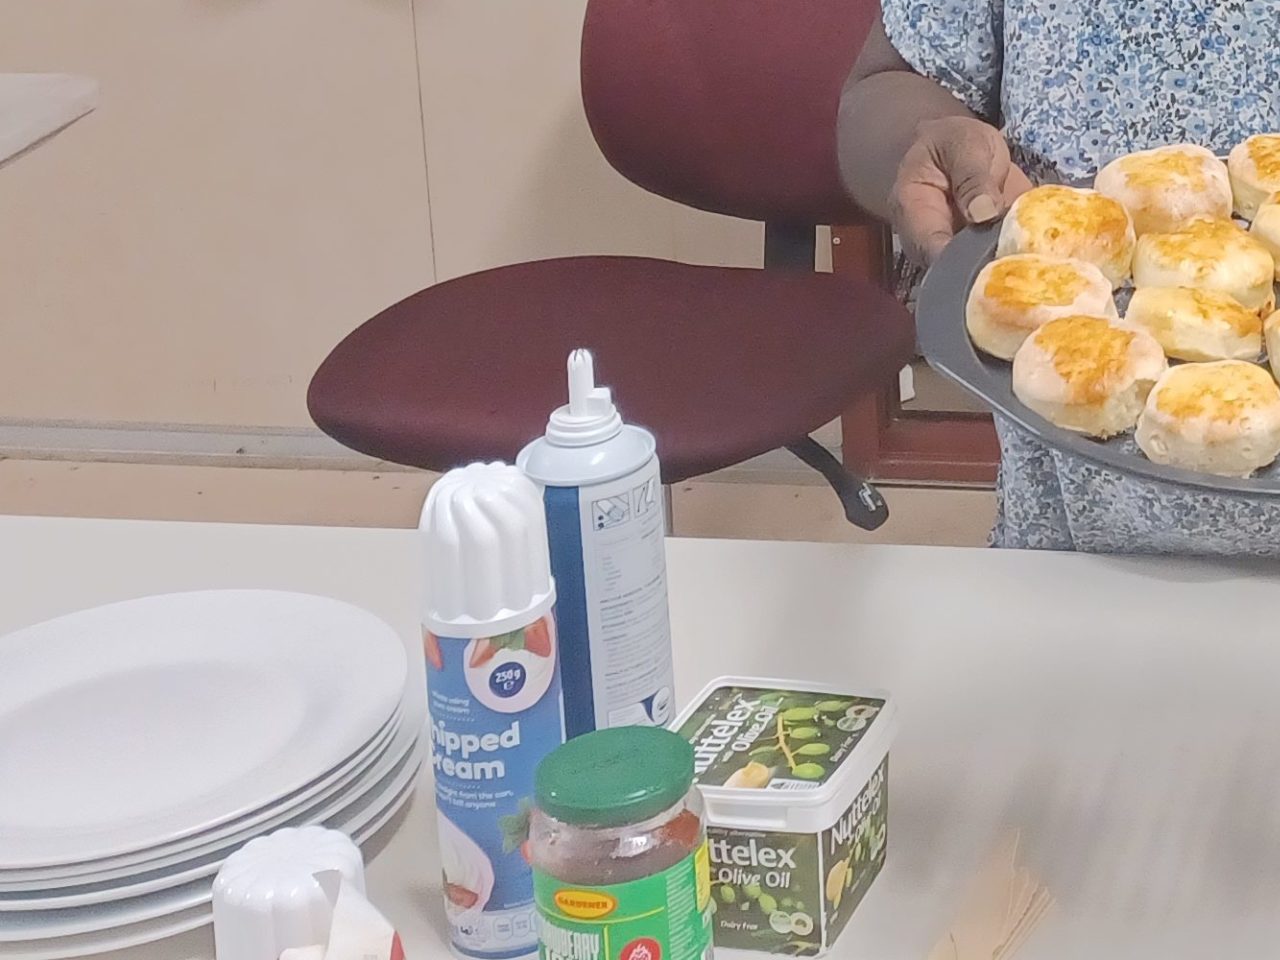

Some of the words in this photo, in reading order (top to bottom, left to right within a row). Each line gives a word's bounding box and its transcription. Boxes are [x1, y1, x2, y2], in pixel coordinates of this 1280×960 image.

[431, 720, 521, 759] hipped
[694, 693, 761, 775] uttelex
[432, 753, 505, 780] ream
[708, 838, 797, 869] ttelex
[718, 867, 761, 886] Olive
[765, 870, 791, 889] Oil
